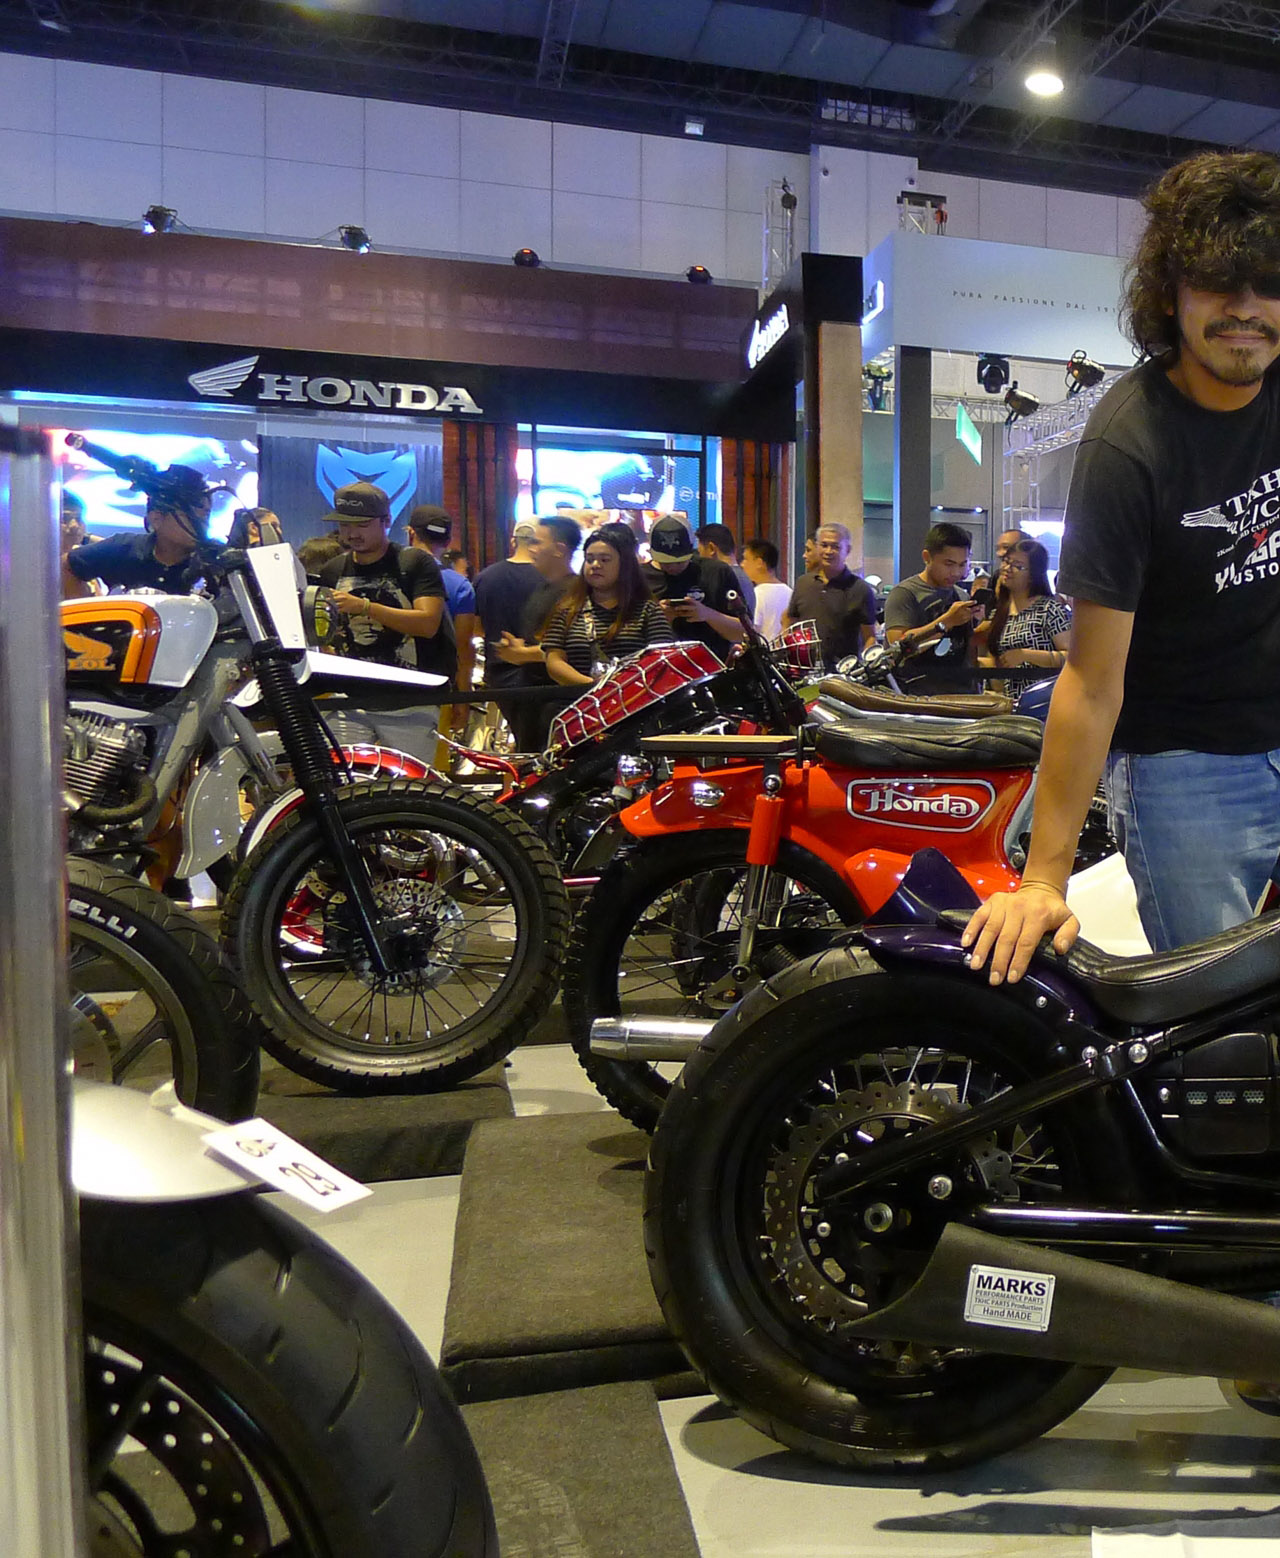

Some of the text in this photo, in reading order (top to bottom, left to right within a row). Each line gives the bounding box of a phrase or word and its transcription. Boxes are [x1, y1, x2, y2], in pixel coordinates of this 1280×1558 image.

[953, 290, 982, 299] PURA
[994, 295, 1054, 307] PASSIONE
[1066, 302, 1086, 310] DAL
[257, 373, 483, 414] HONDA
[859, 788, 980, 819] Honda
[69, 898, 138, 939] ELLI
[976, 1274, 1047, 1297] MARKS
[975, 1289, 1044, 1305] PERFORMANCE PARTS
[991, 1300, 1010, 1308] PARTS
[983, 1306, 1032, 1321] Hand MADE
